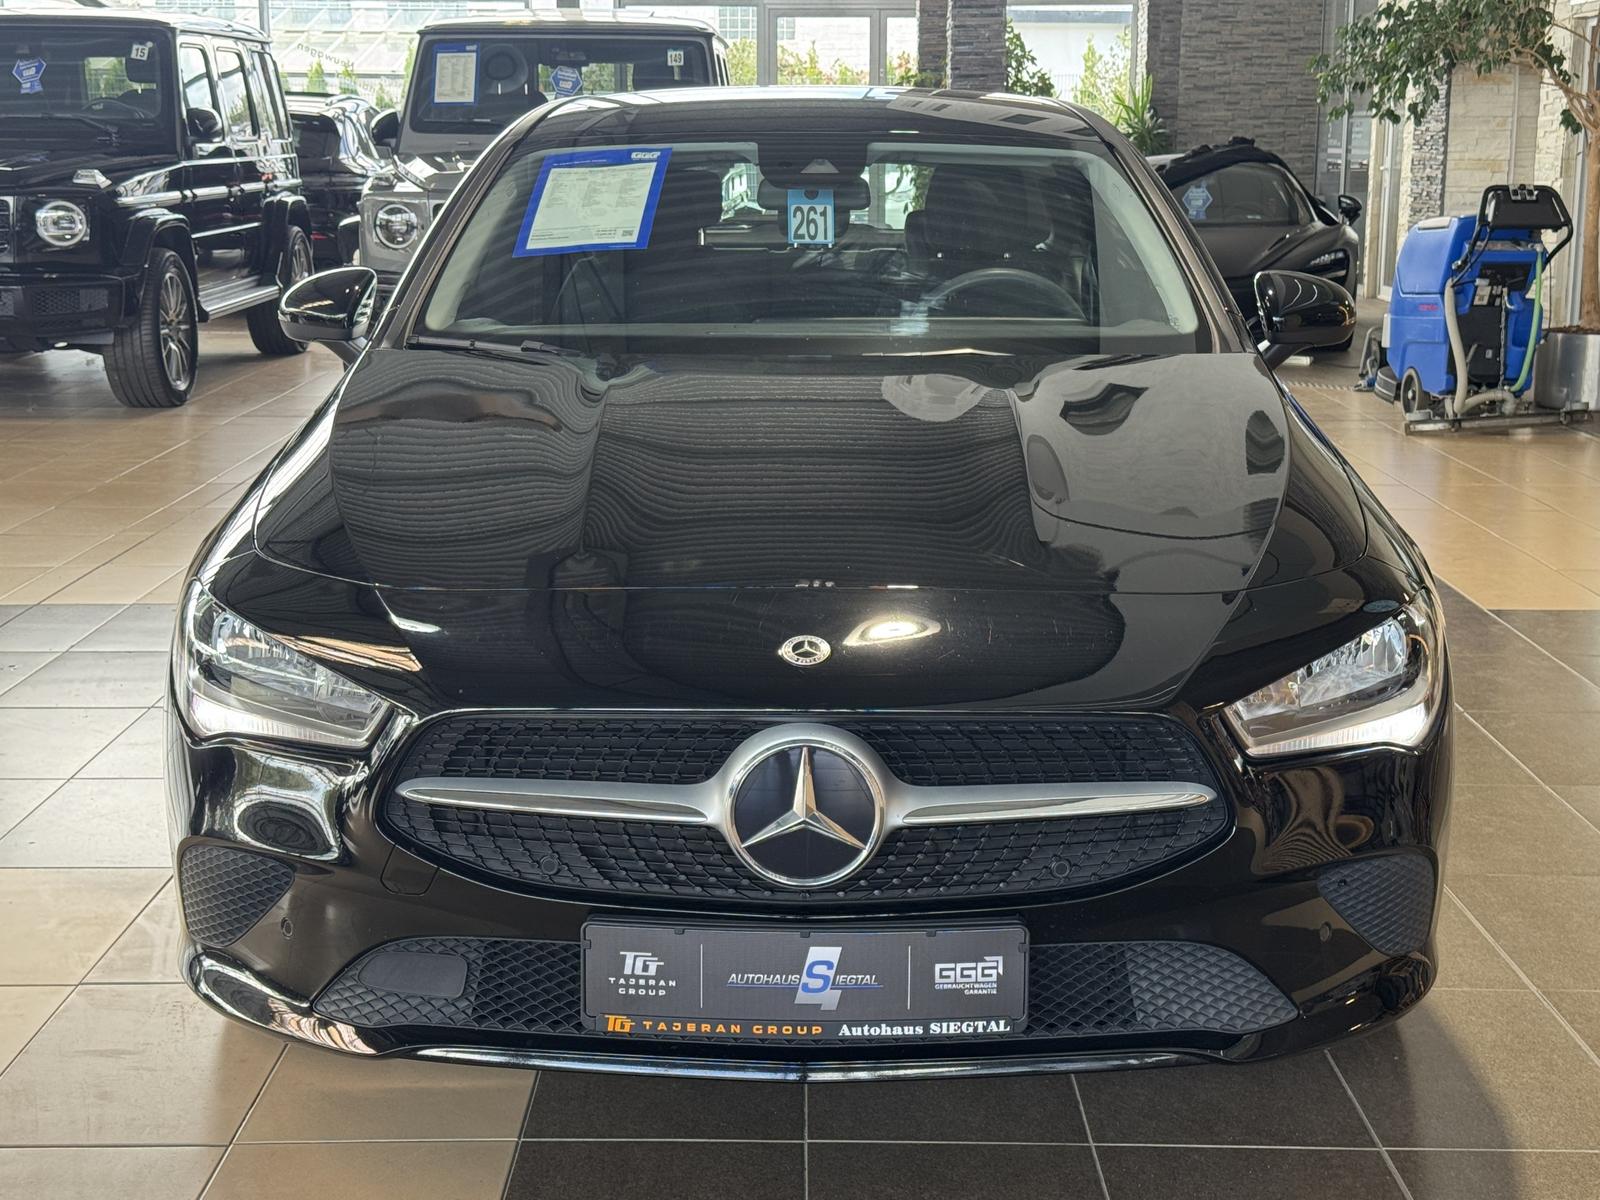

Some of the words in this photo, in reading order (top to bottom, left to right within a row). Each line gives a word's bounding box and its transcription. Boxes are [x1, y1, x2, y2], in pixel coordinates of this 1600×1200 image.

[135, 47, 146, 58] 15
[669, 53, 682, 64] 149
[793, 206, 828, 241] 261
[620, 951, 664, 976] TG
[935, 962, 998, 983] GGG
[608, 977, 676, 987] TAJERAN
[727, 973, 801, 985] AUTOHAUS
[618, 988, 666, 996] GROUP
[604, 1014, 636, 1033] TG
[643, 1021, 741, 1034] TAJERAN
[752, 1024, 823, 1035] GROUP
[838, 1023, 924, 1037] Autohaus
[930, 1019, 1010, 1035] SIEGTAL
